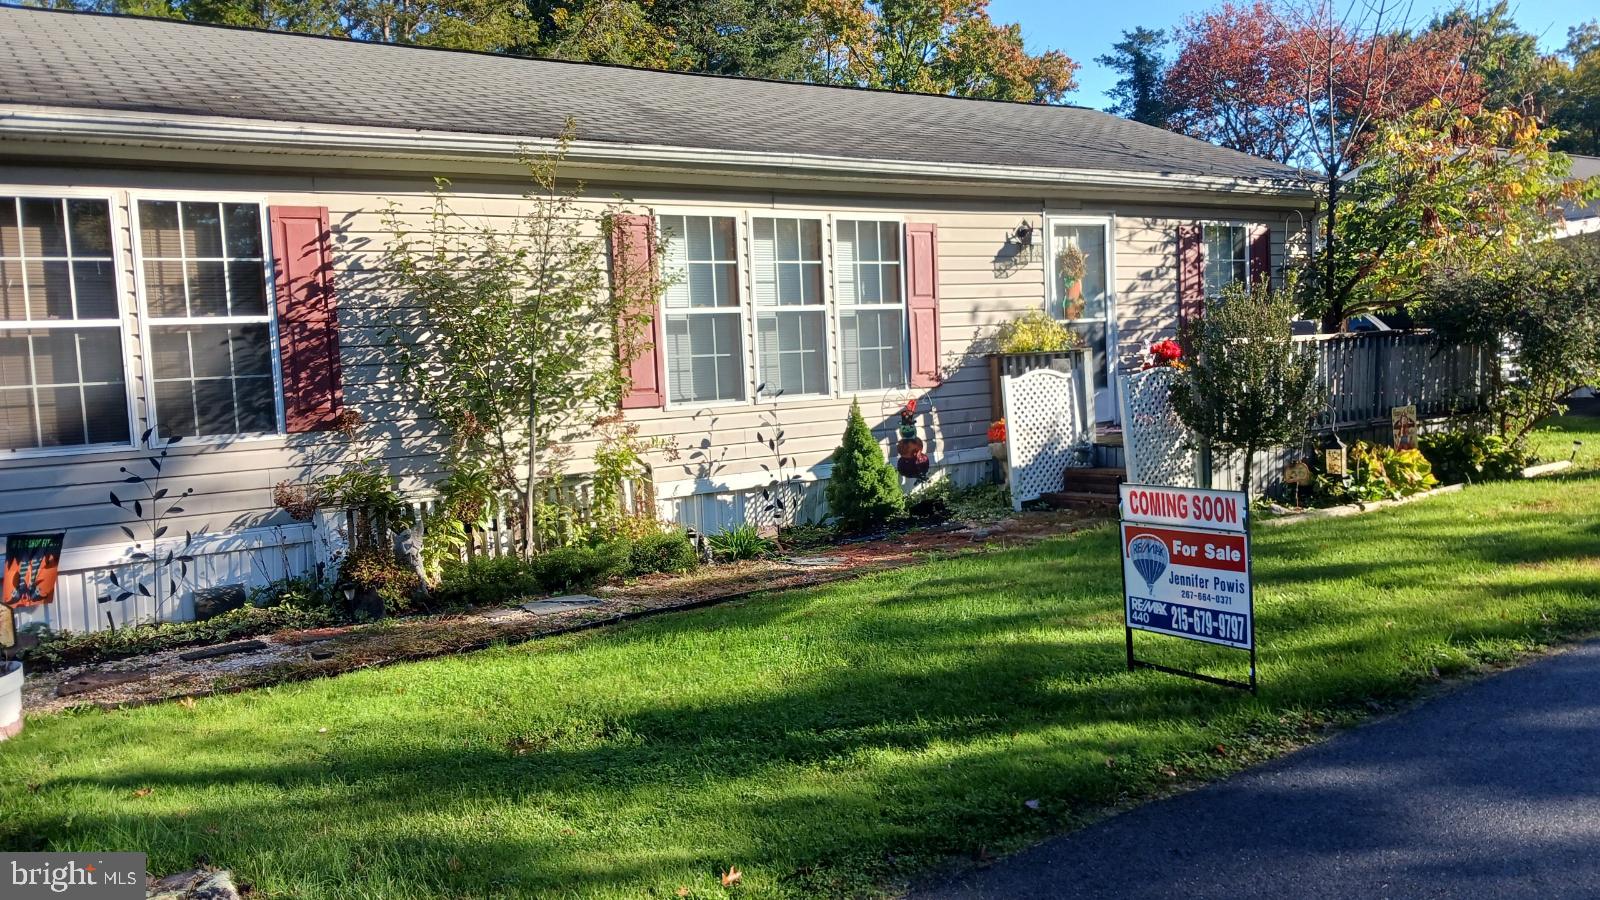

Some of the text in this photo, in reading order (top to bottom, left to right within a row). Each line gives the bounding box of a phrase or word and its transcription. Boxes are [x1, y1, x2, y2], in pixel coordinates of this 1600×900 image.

[1129, 490, 1236, 523] COMING SOON
[1134, 544, 1164, 556] RE/MAX
[1173, 540, 1241, 562] For Sale
[1169, 571, 1245, 594] Jennifer Powis
[1131, 599, 1167, 615] RE/MAX
[1132, 612, 1149, 623] 440
[1172, 606, 1244, 640] 215-679-9797
